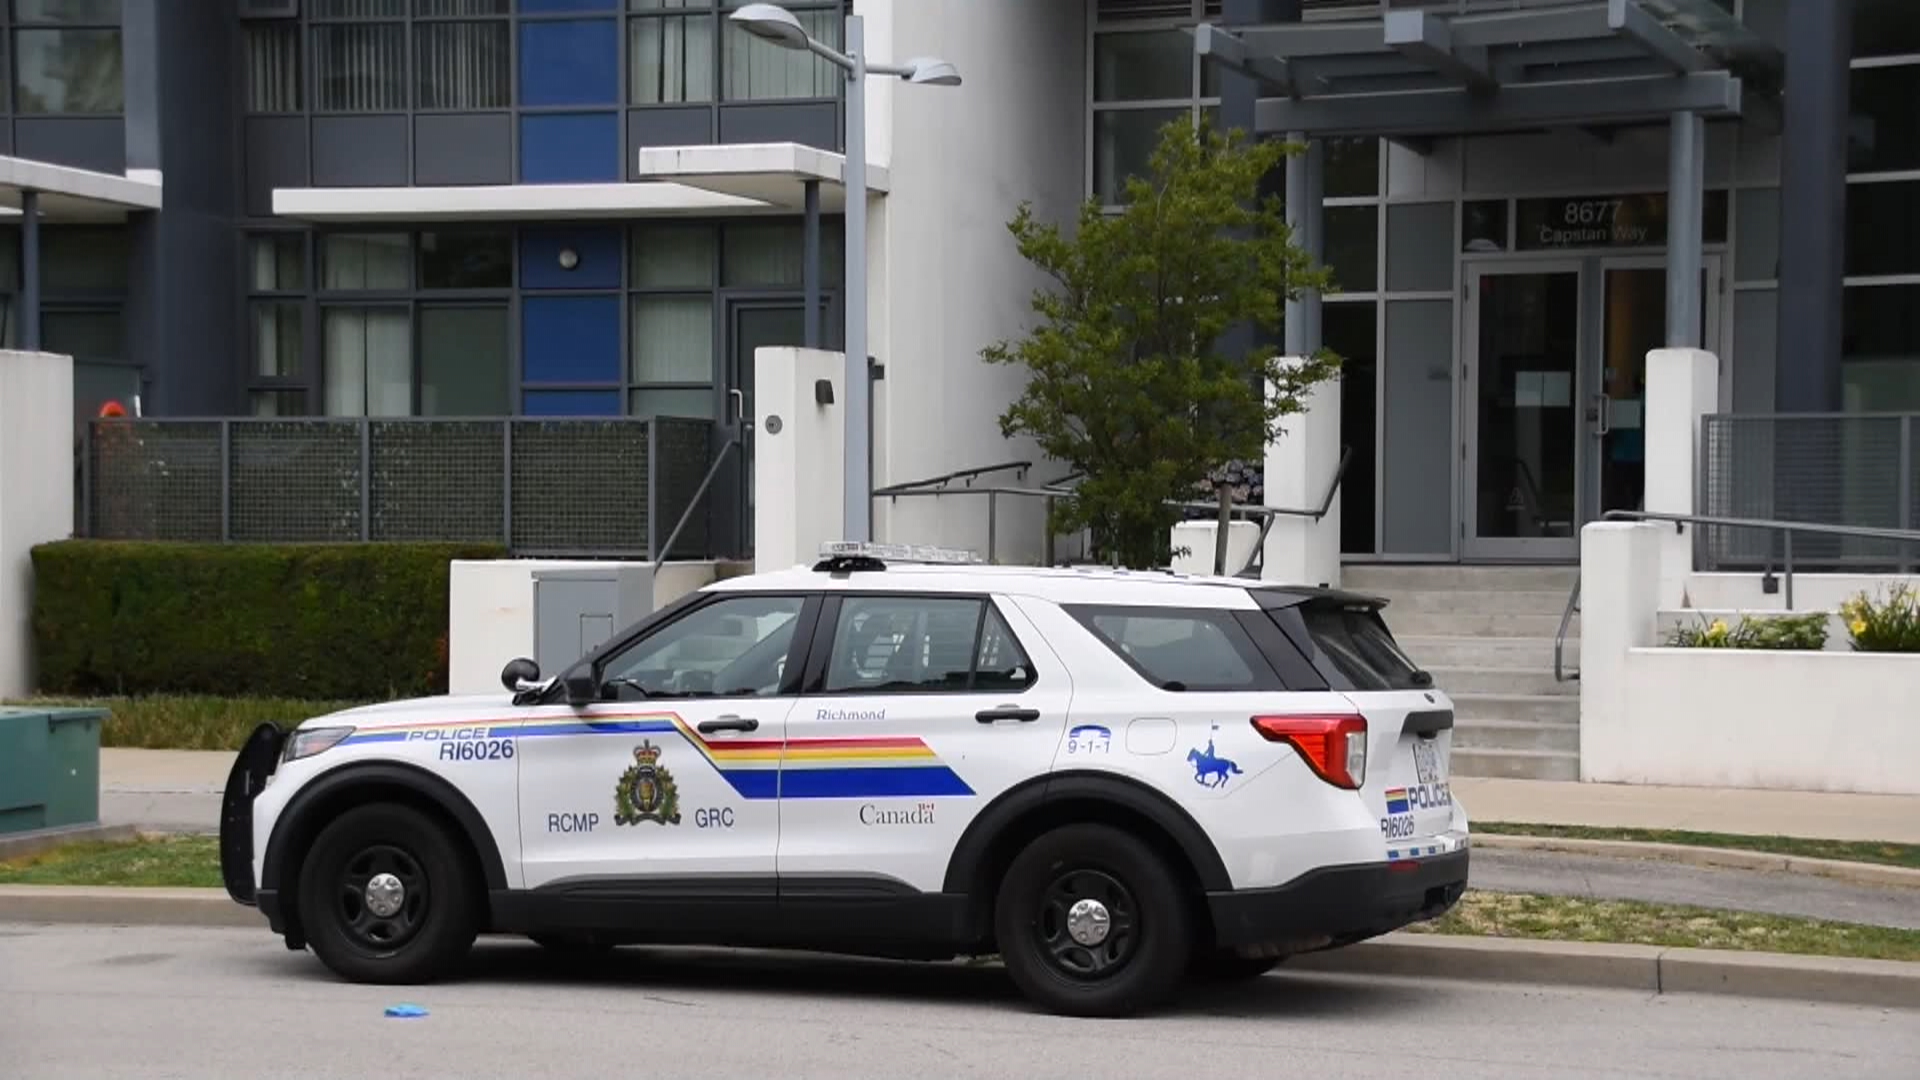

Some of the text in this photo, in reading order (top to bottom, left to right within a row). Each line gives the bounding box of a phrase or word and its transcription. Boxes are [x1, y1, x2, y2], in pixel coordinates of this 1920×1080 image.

[1564, 200, 1624, 224] 8677
[1540, 225, 1648, 246] Capstan Way
[816, 708, 886, 721] Richmond
[409, 727, 487, 741] POLICE
[439, 739, 514, 760] RI6026
[1408, 783, 1452, 810] POLICE
[548, 807, 735, 832] RCMP GRC
[859, 803, 935, 826] Canada
[1381, 816, 1415, 838] RI6026
